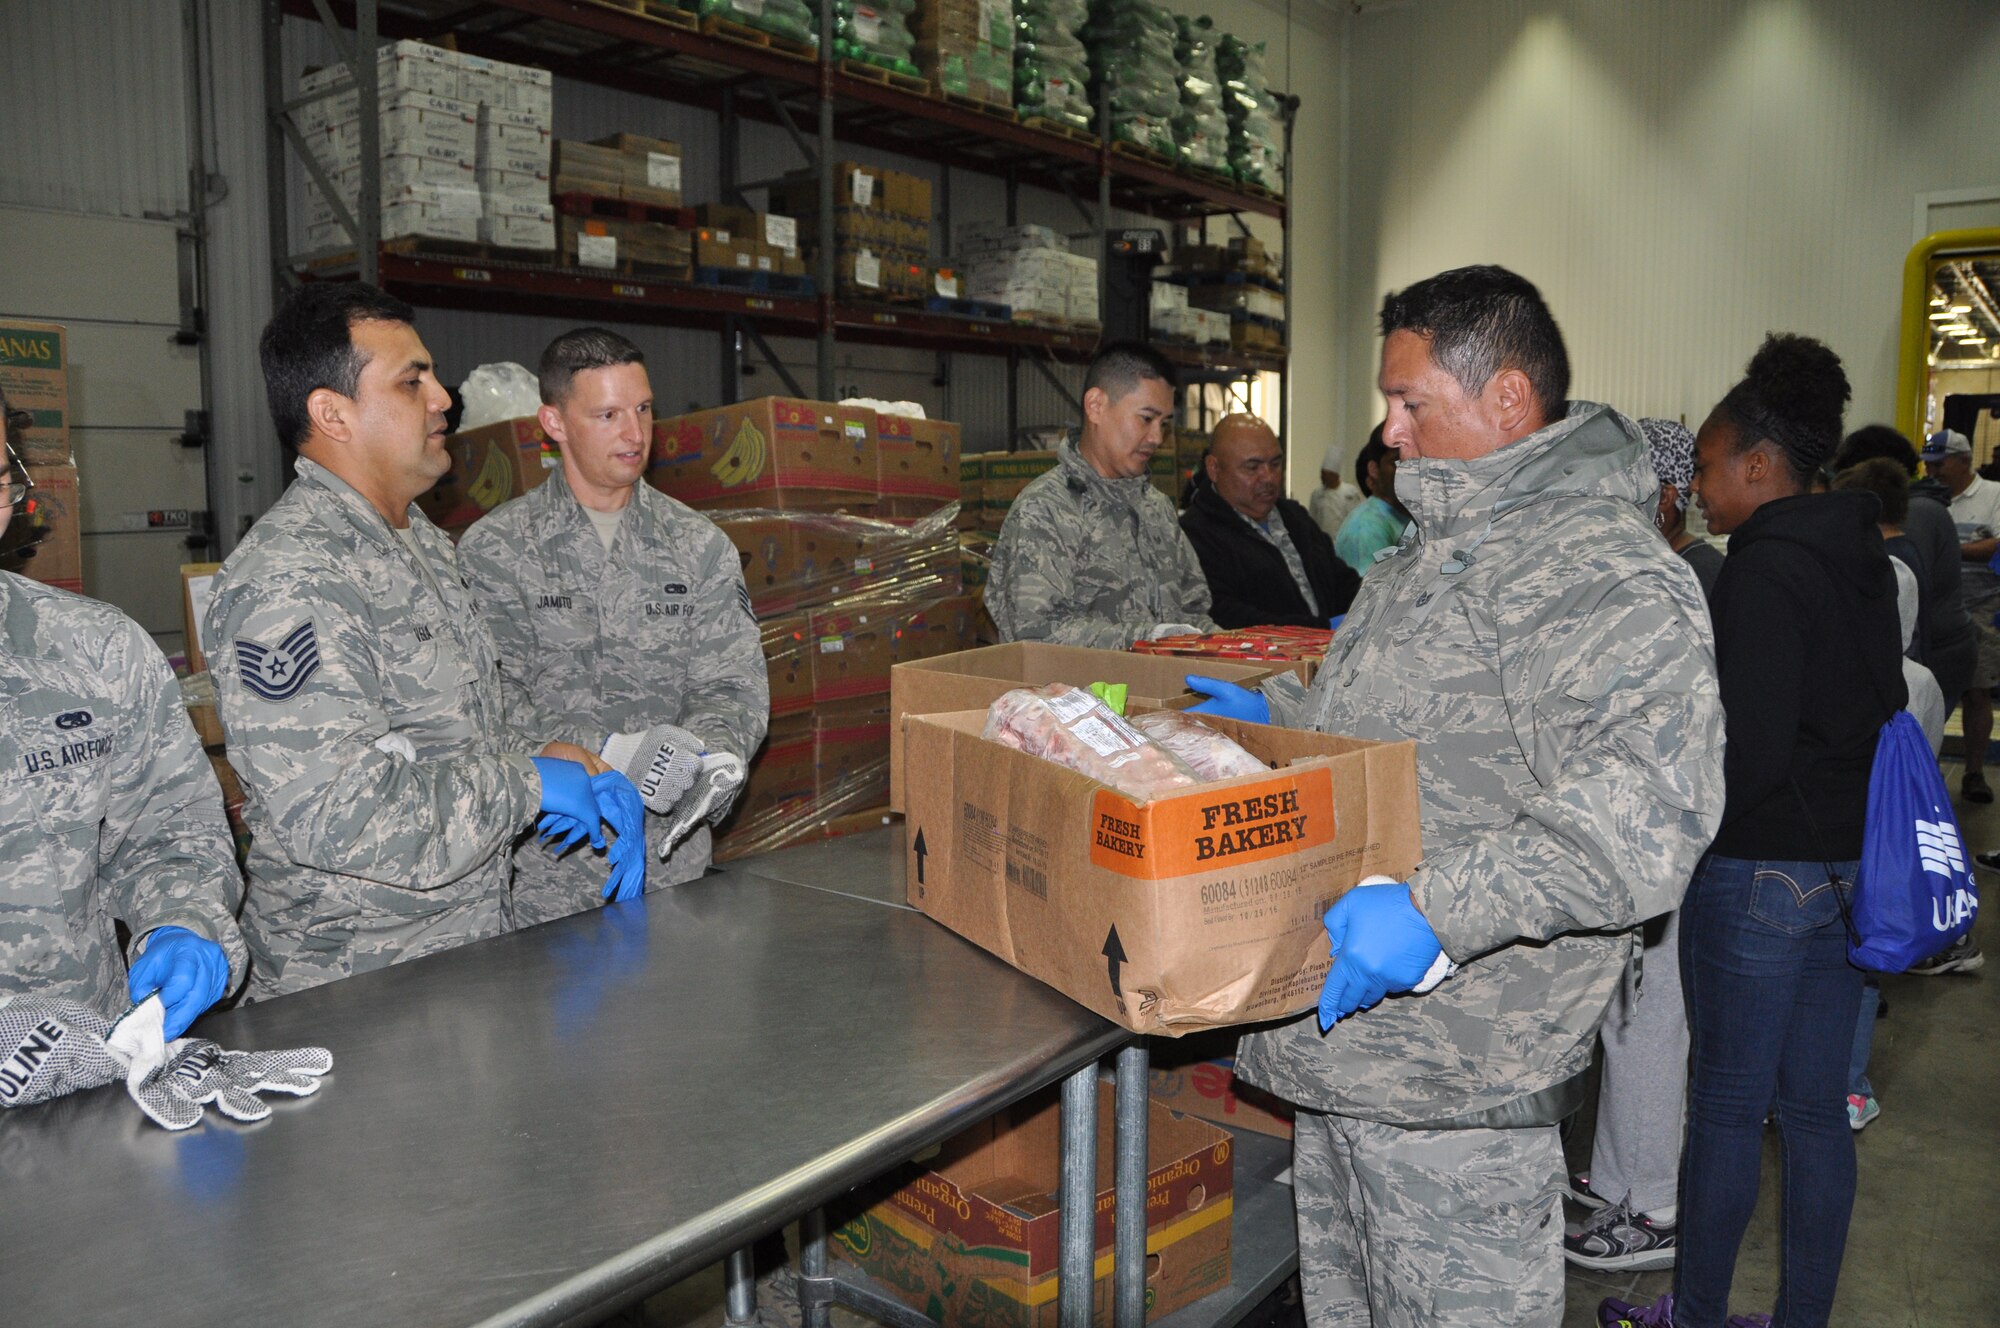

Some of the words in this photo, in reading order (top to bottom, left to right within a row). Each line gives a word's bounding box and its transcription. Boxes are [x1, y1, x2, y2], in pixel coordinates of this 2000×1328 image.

[164, 511, 187, 522] TKO
[665, 603, 680, 616] AIR
[24, 750, 59, 773] U.S.
[61, 742, 88, 767] AIR
[640, 743, 675, 798] ULINE
[1100, 813, 1141, 840] FRESH
[1201, 789, 1299, 831] FRESH
[1096, 830, 1146, 859] BAKERY
[1195, 815, 1308, 861] BAKERY
[1200, 879, 1237, 906] 60084
[0, 1019, 63, 1099] ULINE
[894, 1191, 935, 1226] Premi
[916, 1177, 971, 1220] Organi
